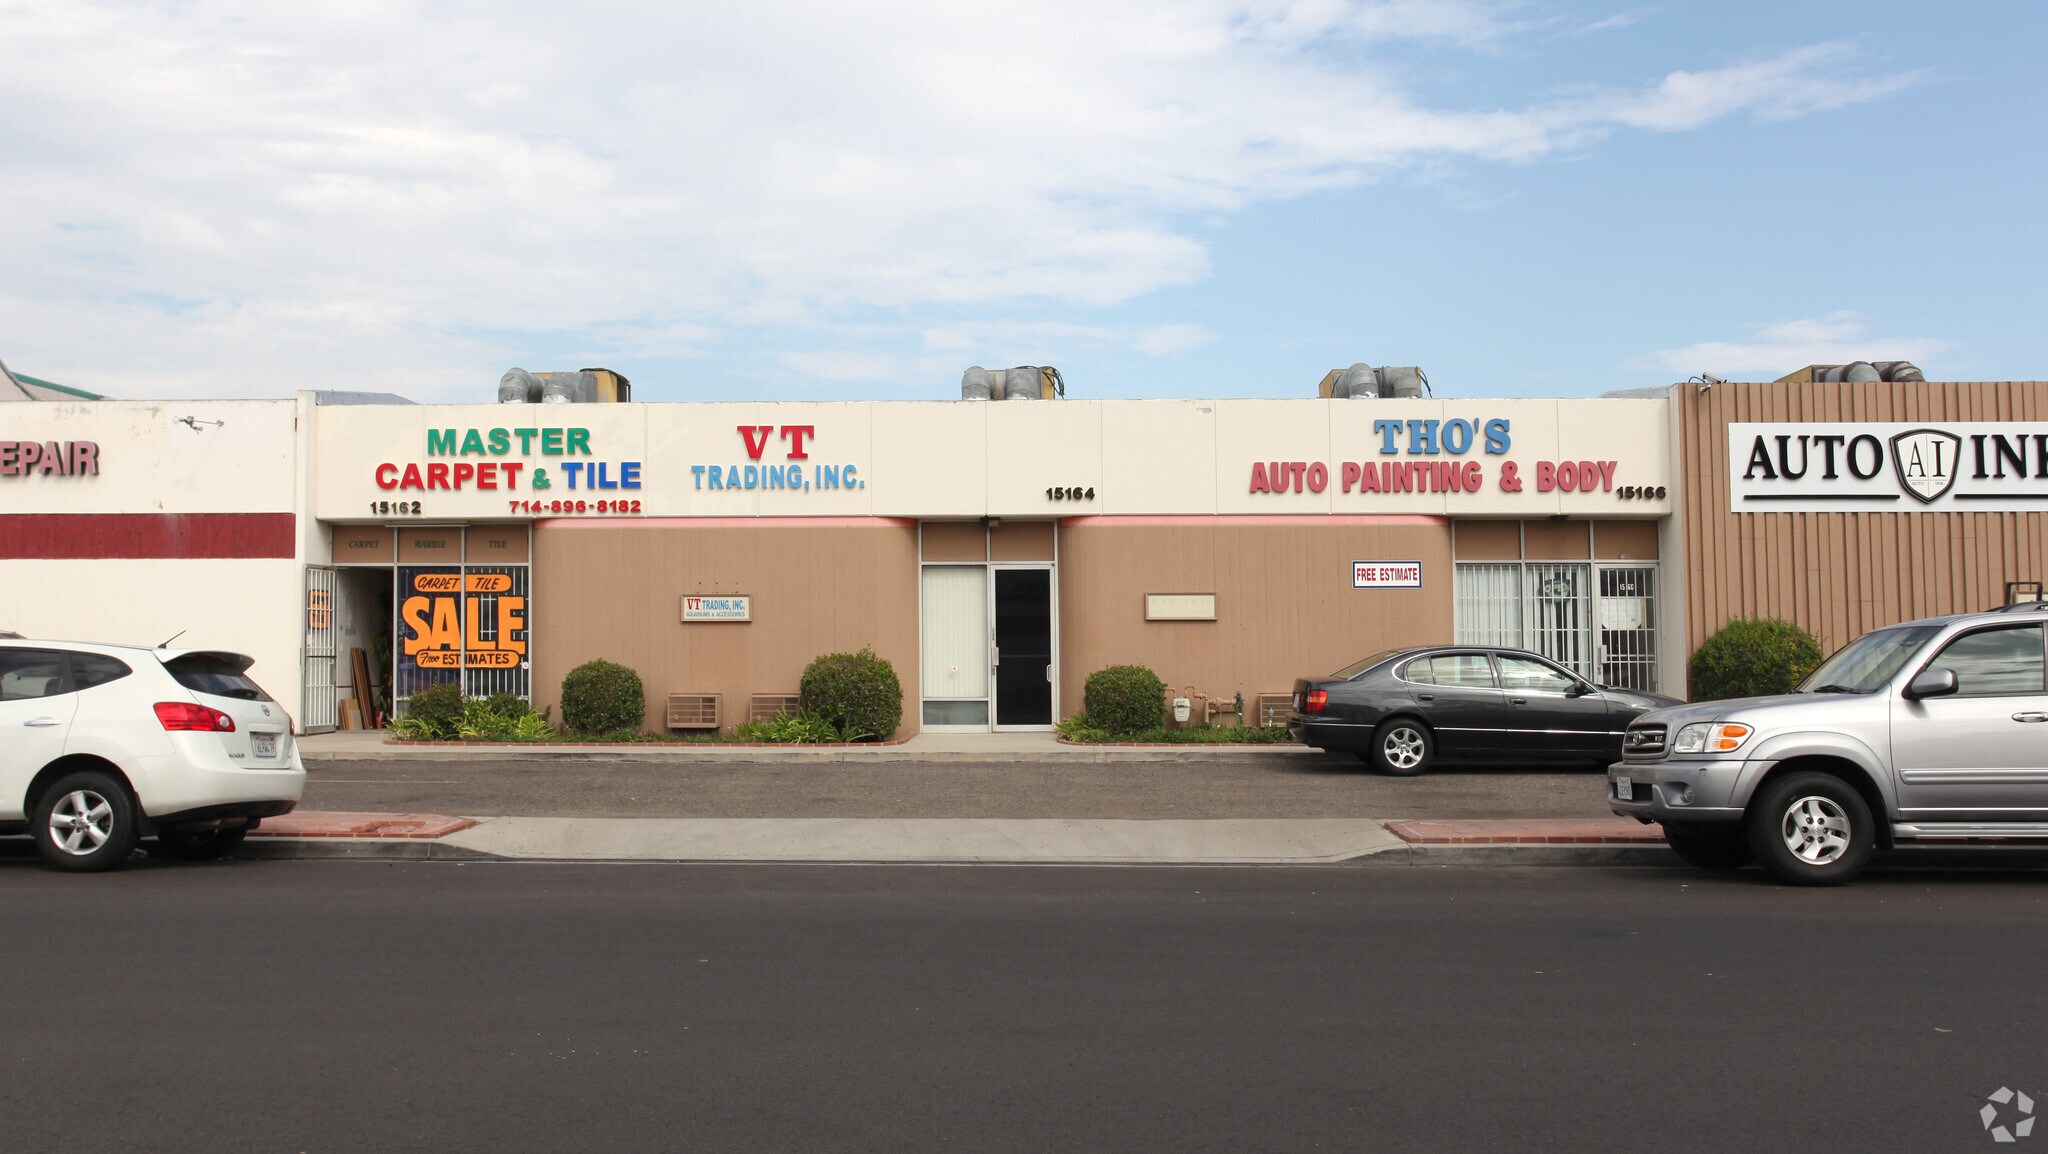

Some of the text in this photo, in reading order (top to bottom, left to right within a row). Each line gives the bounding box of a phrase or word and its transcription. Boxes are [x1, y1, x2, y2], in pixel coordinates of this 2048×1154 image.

[427, 428, 592, 456] MASTER
[737, 425, 815, 460] VT
[1374, 417, 1511, 455] THO'S
[1743, 434, 1884, 480] AUTO
[375, 462, 642, 490] CARPET & TILE
[1250, 461, 1619, 493] AUTO PAINTING & BODY
[1046, 487, 1095, 501] 15164
[1617, 486, 1667, 500] 15166
[370, 501, 422, 514] 15162
[509, 500, 642, 514] 714-896-8182
[349, 540, 380, 549] CARPET
[414, 540, 447, 549] MARBLE
[488, 540, 508, 549] TILE
[1356, 568, 1418, 581] FREE ESTIMATE
[417, 577, 500, 590] CARPET TILE
[687, 598, 701, 610] VT
[733, 600, 745, 610] INC.
[402, 596, 526, 656] SALE
